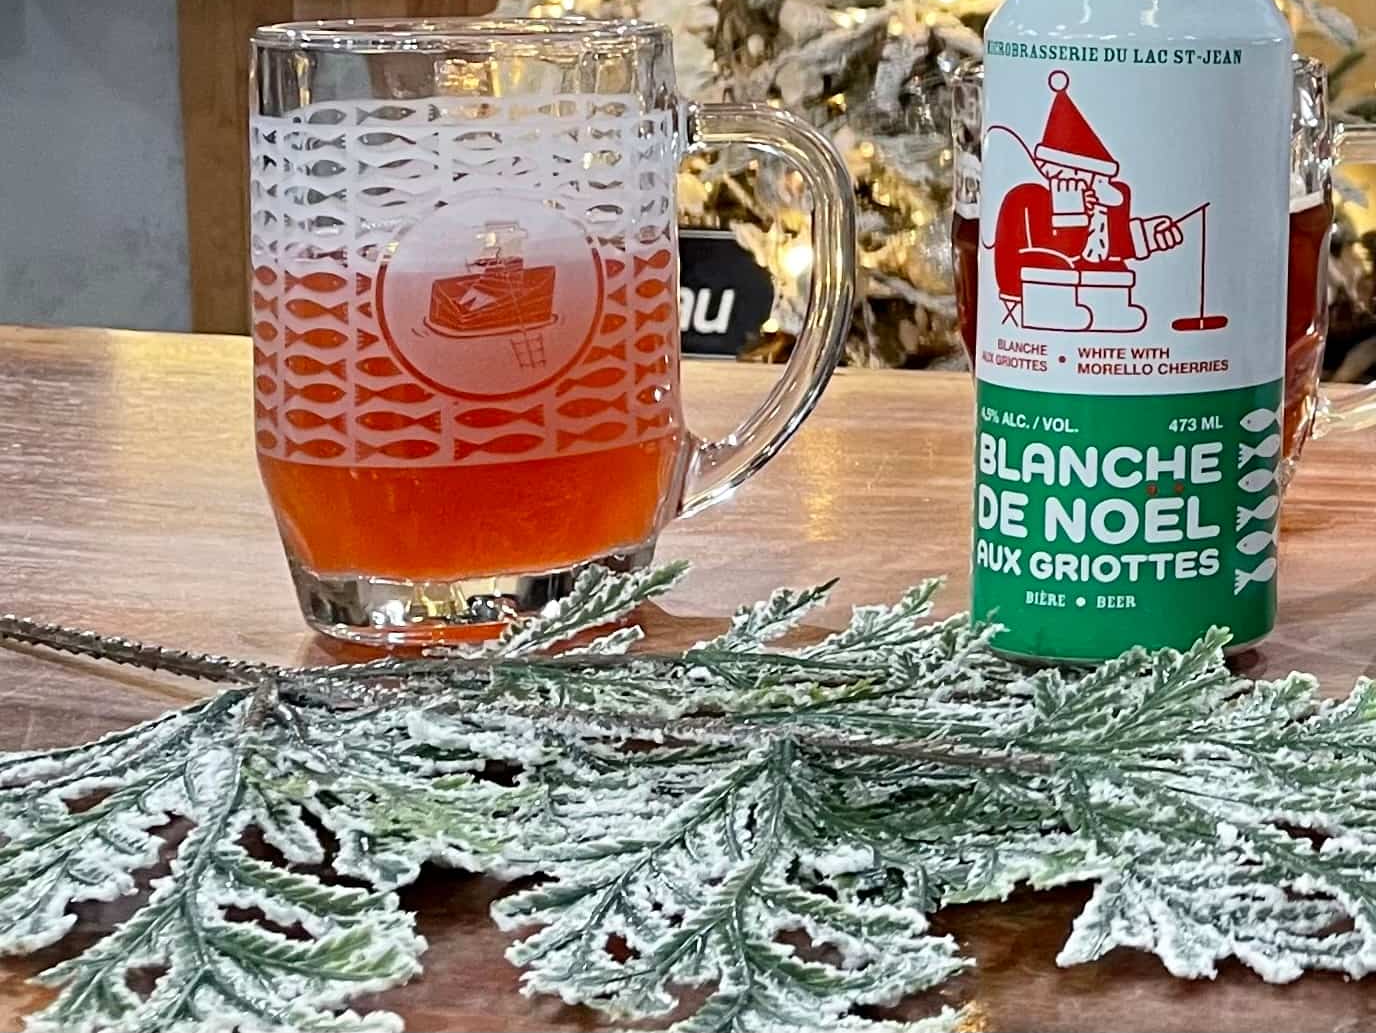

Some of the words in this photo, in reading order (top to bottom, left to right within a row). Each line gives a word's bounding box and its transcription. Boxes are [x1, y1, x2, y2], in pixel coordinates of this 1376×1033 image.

[1103, 47, 1128, 63] DU
[1133, 48, 1168, 64] LAC
[1173, 49, 1243, 65] ST-JEAN
[997, 337, 1049, 357] BLANCHE
[1077, 347, 1126, 361] WHITE
[1131, 347, 1170, 360] WITH
[1077, 362, 1154, 376] MORELLO
[1157, 359, 1229, 375] CHERRIES
[1168, 418, 1198, 433] 473
[1201, 415, 1224, 430] ML
[979, 431, 1224, 489] BLANCHE
[977, 482, 1029, 539] DE
[976, 538, 1022, 576] AUX
[1028, 548, 1220, 584] GRIOTTES
[1025, 589, 1067, 608] BIÈRE
[1096, 595, 1137, 609] BEER
